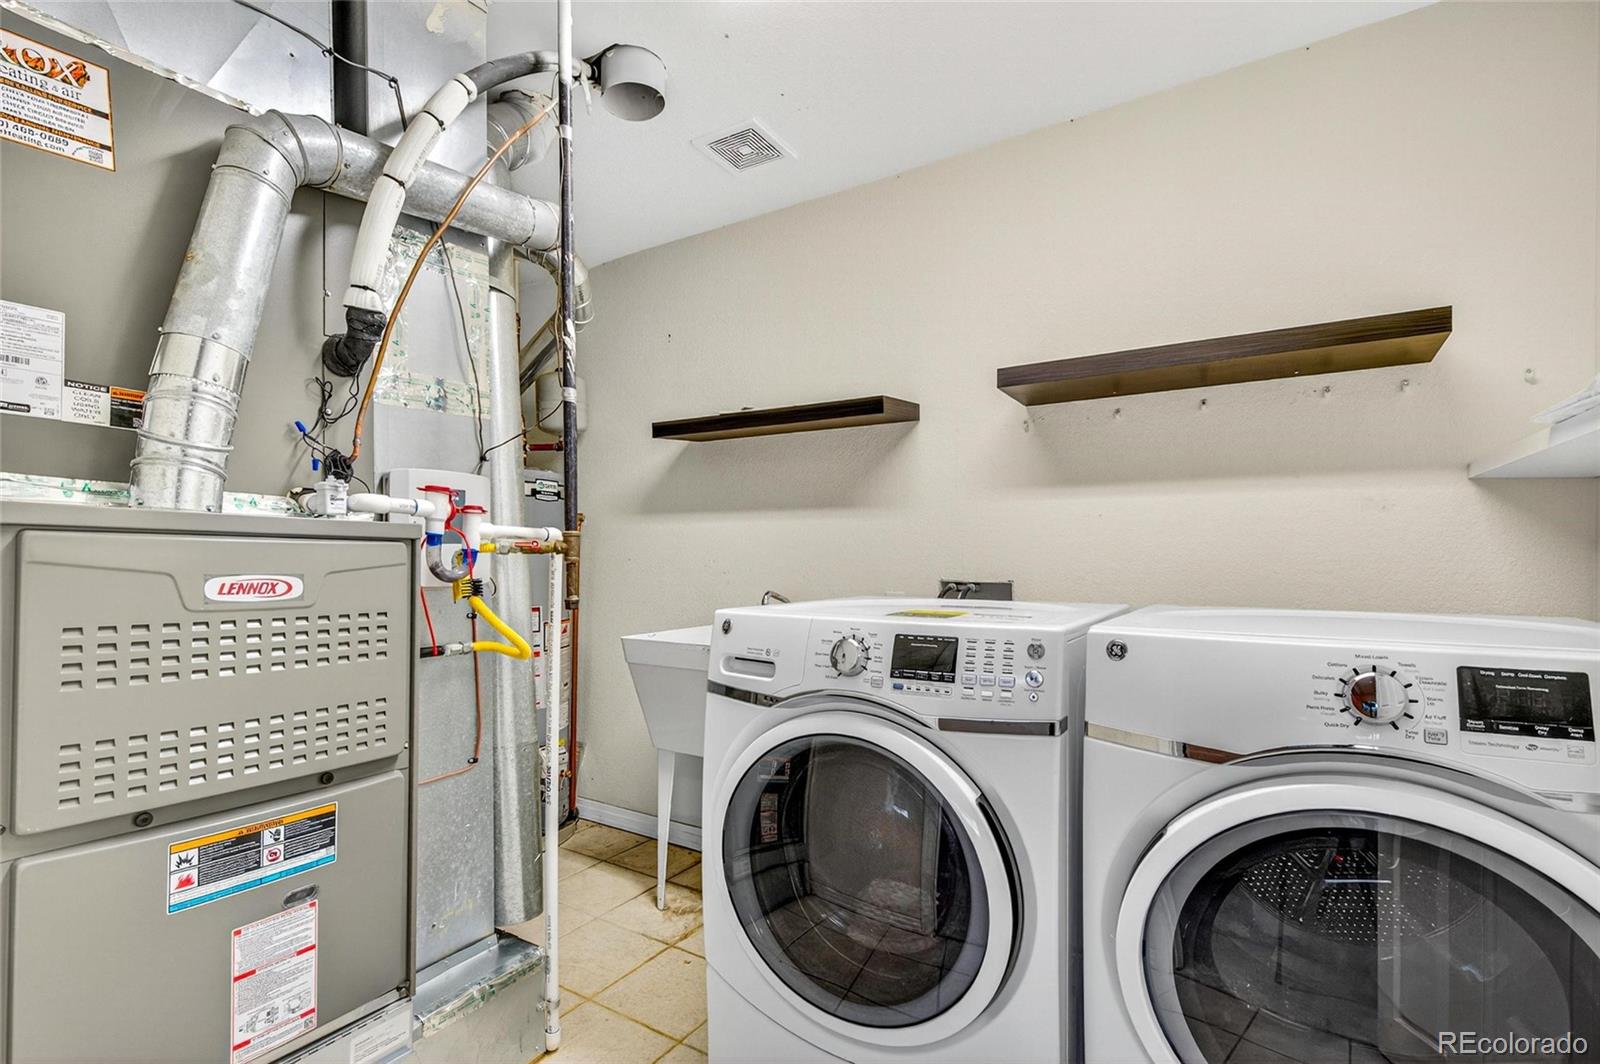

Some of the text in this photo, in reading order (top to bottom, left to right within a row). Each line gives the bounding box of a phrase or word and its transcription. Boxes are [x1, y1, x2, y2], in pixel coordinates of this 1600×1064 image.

[61, 86, 82, 101] air
[67, 381, 108, 392] NOTICE
[217, 582, 279, 596] LENNOX
